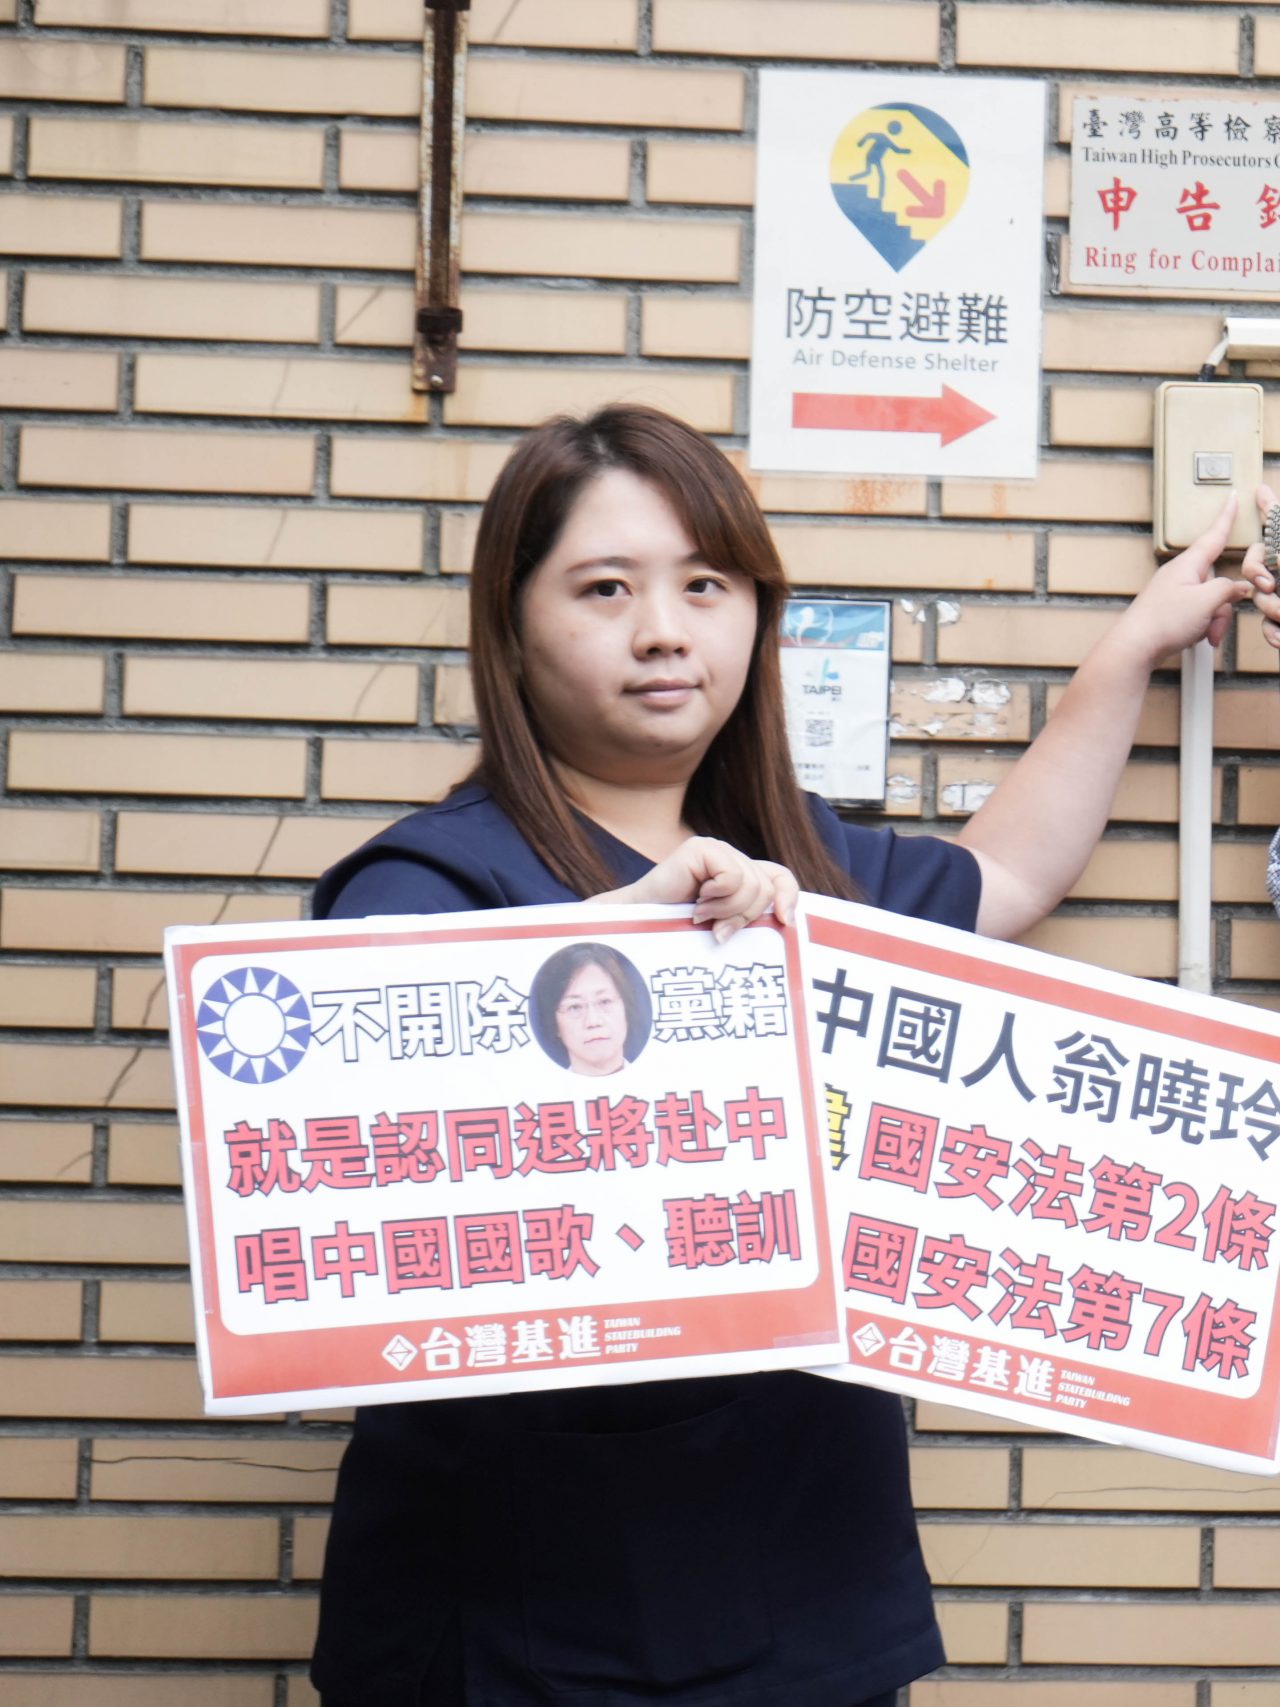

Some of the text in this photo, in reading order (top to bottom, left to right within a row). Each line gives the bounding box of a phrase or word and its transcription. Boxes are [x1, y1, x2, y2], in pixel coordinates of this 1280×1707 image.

[1082, 147, 1137, 164] Taiwan
[1141, 149, 1178, 168] High
[1182, 150, 1271, 168] Prosecutors
[1086, 247, 1137, 273] Ring
[1150, 249, 1181, 270] for
[786, 286, 1008, 346] 防空避難
[793, 349, 1000, 372] Air Defense Shelter
[802, 684, 842, 695] TAIPEI
[311, 962, 788, 1063] 不開除 黨籍
[224, 1086, 788, 1198] 就是認同退將赴中
[858, 1101, 1278, 1272] 國安法第2條
[234, 1190, 801, 1304] 唱中國國歌、聽訓
[841, 1212, 1258, 1380] 國安法第7條
[604, 1317, 640, 1329] TAIWAN
[604, 1327, 681, 1341] STATEBUILDING
[420, 1315, 601, 1372] 台灣基進
[605, 1342, 638, 1355] PARTY
[889, 1326, 1056, 1402] 台灣基進
[1060, 1369, 1096, 1386] TAIWAN
[1055, 1394, 1088, 1409] PARTY
[1057, 1382, 1131, 1406] STATEBUILDING
